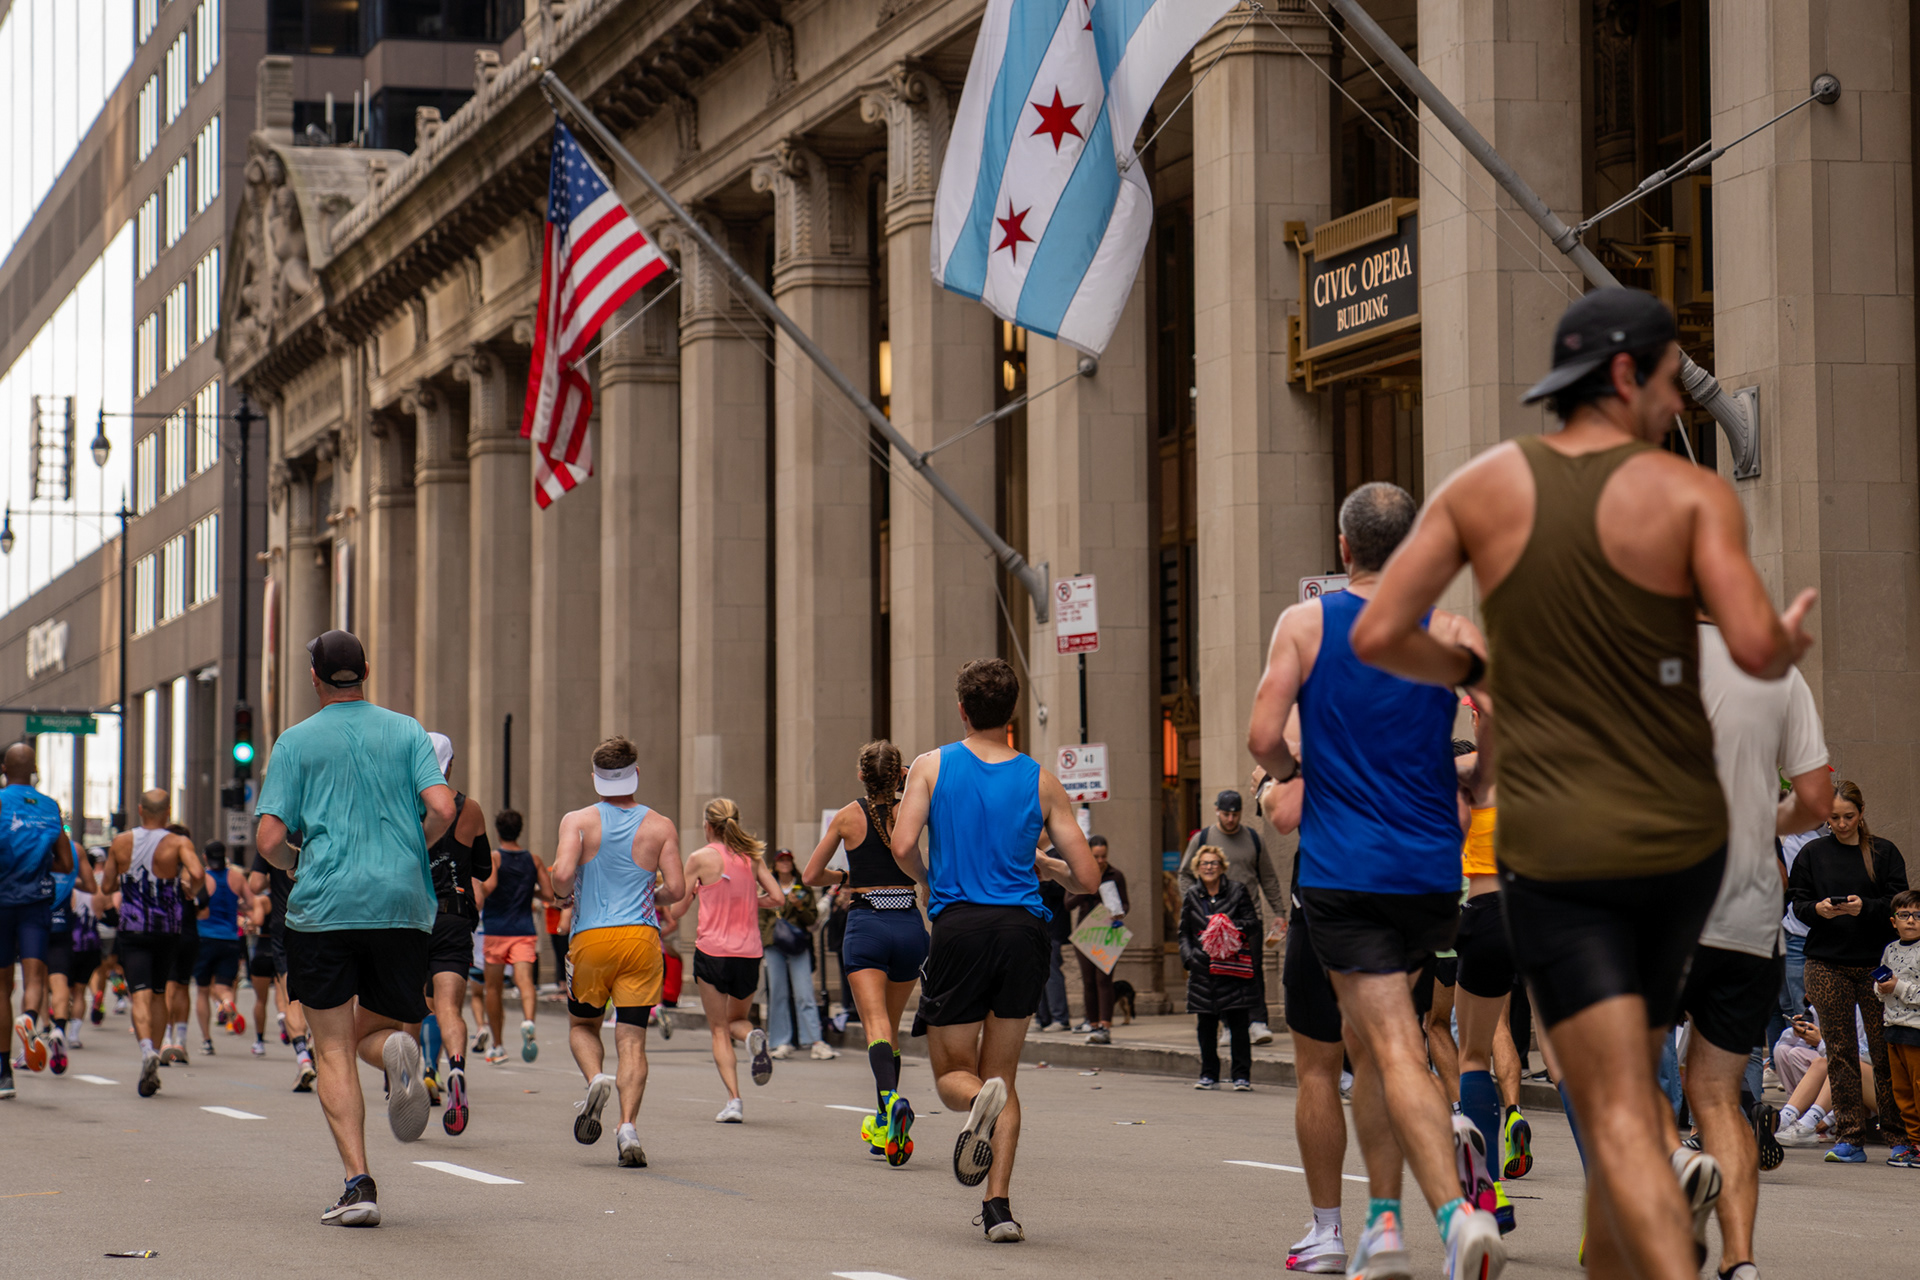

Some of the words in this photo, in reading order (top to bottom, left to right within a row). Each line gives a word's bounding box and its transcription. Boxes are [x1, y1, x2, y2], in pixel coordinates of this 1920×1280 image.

[1314, 263, 1357, 307] CIVIC
[1361, 244, 1412, 291] OPERA
[1337, 293, 1389, 332] BUILDING
